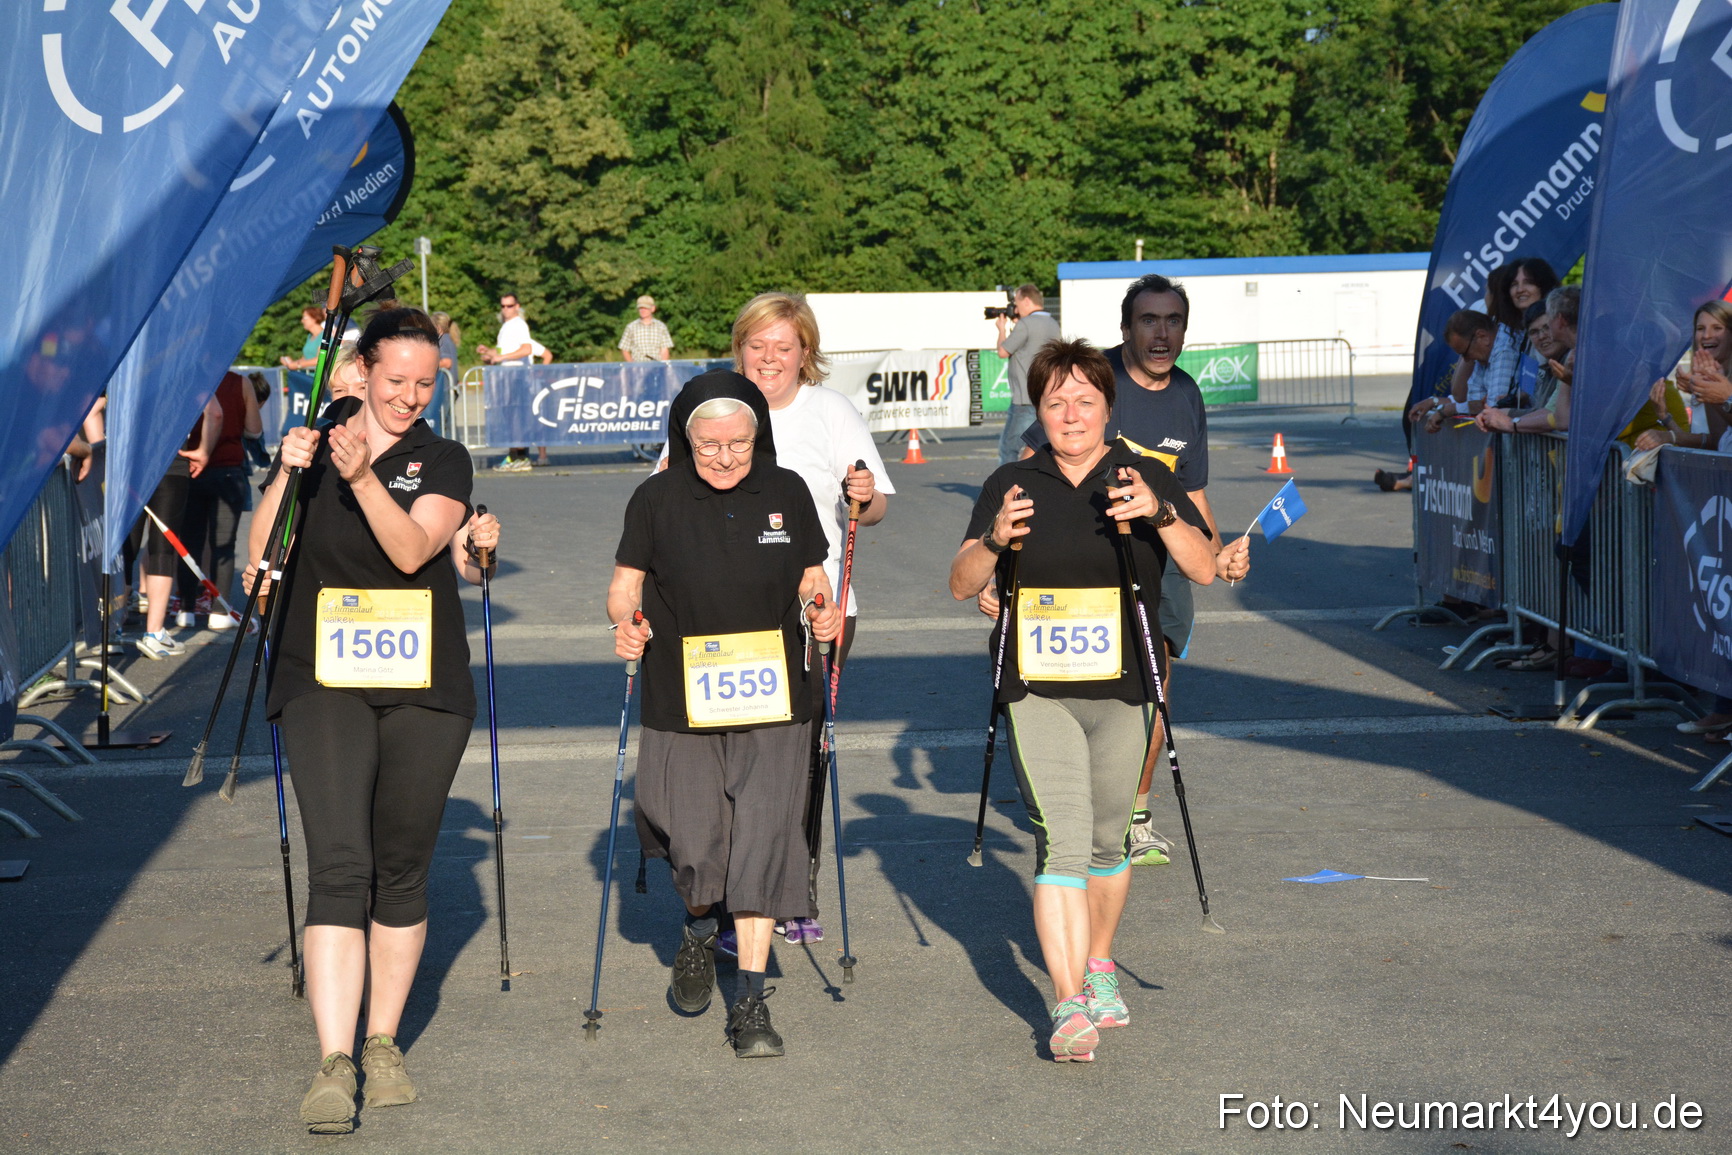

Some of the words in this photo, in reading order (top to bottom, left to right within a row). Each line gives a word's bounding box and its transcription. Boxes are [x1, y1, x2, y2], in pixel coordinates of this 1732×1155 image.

[296, 0, 393, 140] AUTOM
[343, 162, 397, 210] Medien
[1555, 174, 1595, 221] Druck
[1441, 122, 1603, 309] Frischmann
[1197, 354, 1251, 385] AOK
[866, 370, 929, 405] swn
[557, 396, 670, 420] Fischer
[568, 420, 661, 433] AUTOMOBILE
[334, 605, 374, 614] firmenlauf
[1033, 604, 1068, 612] firmenlauf
[329, 628, 419, 660] 1560
[699, 649, 735, 658] firmenlauf
[1029, 625, 1110, 655] 1553
[1138, 603, 1150, 635] NORDIC
[1145, 634, 1159, 675] WALKING
[1153, 674, 1165, 703] STOCK
[697, 667, 778, 701] 1559
